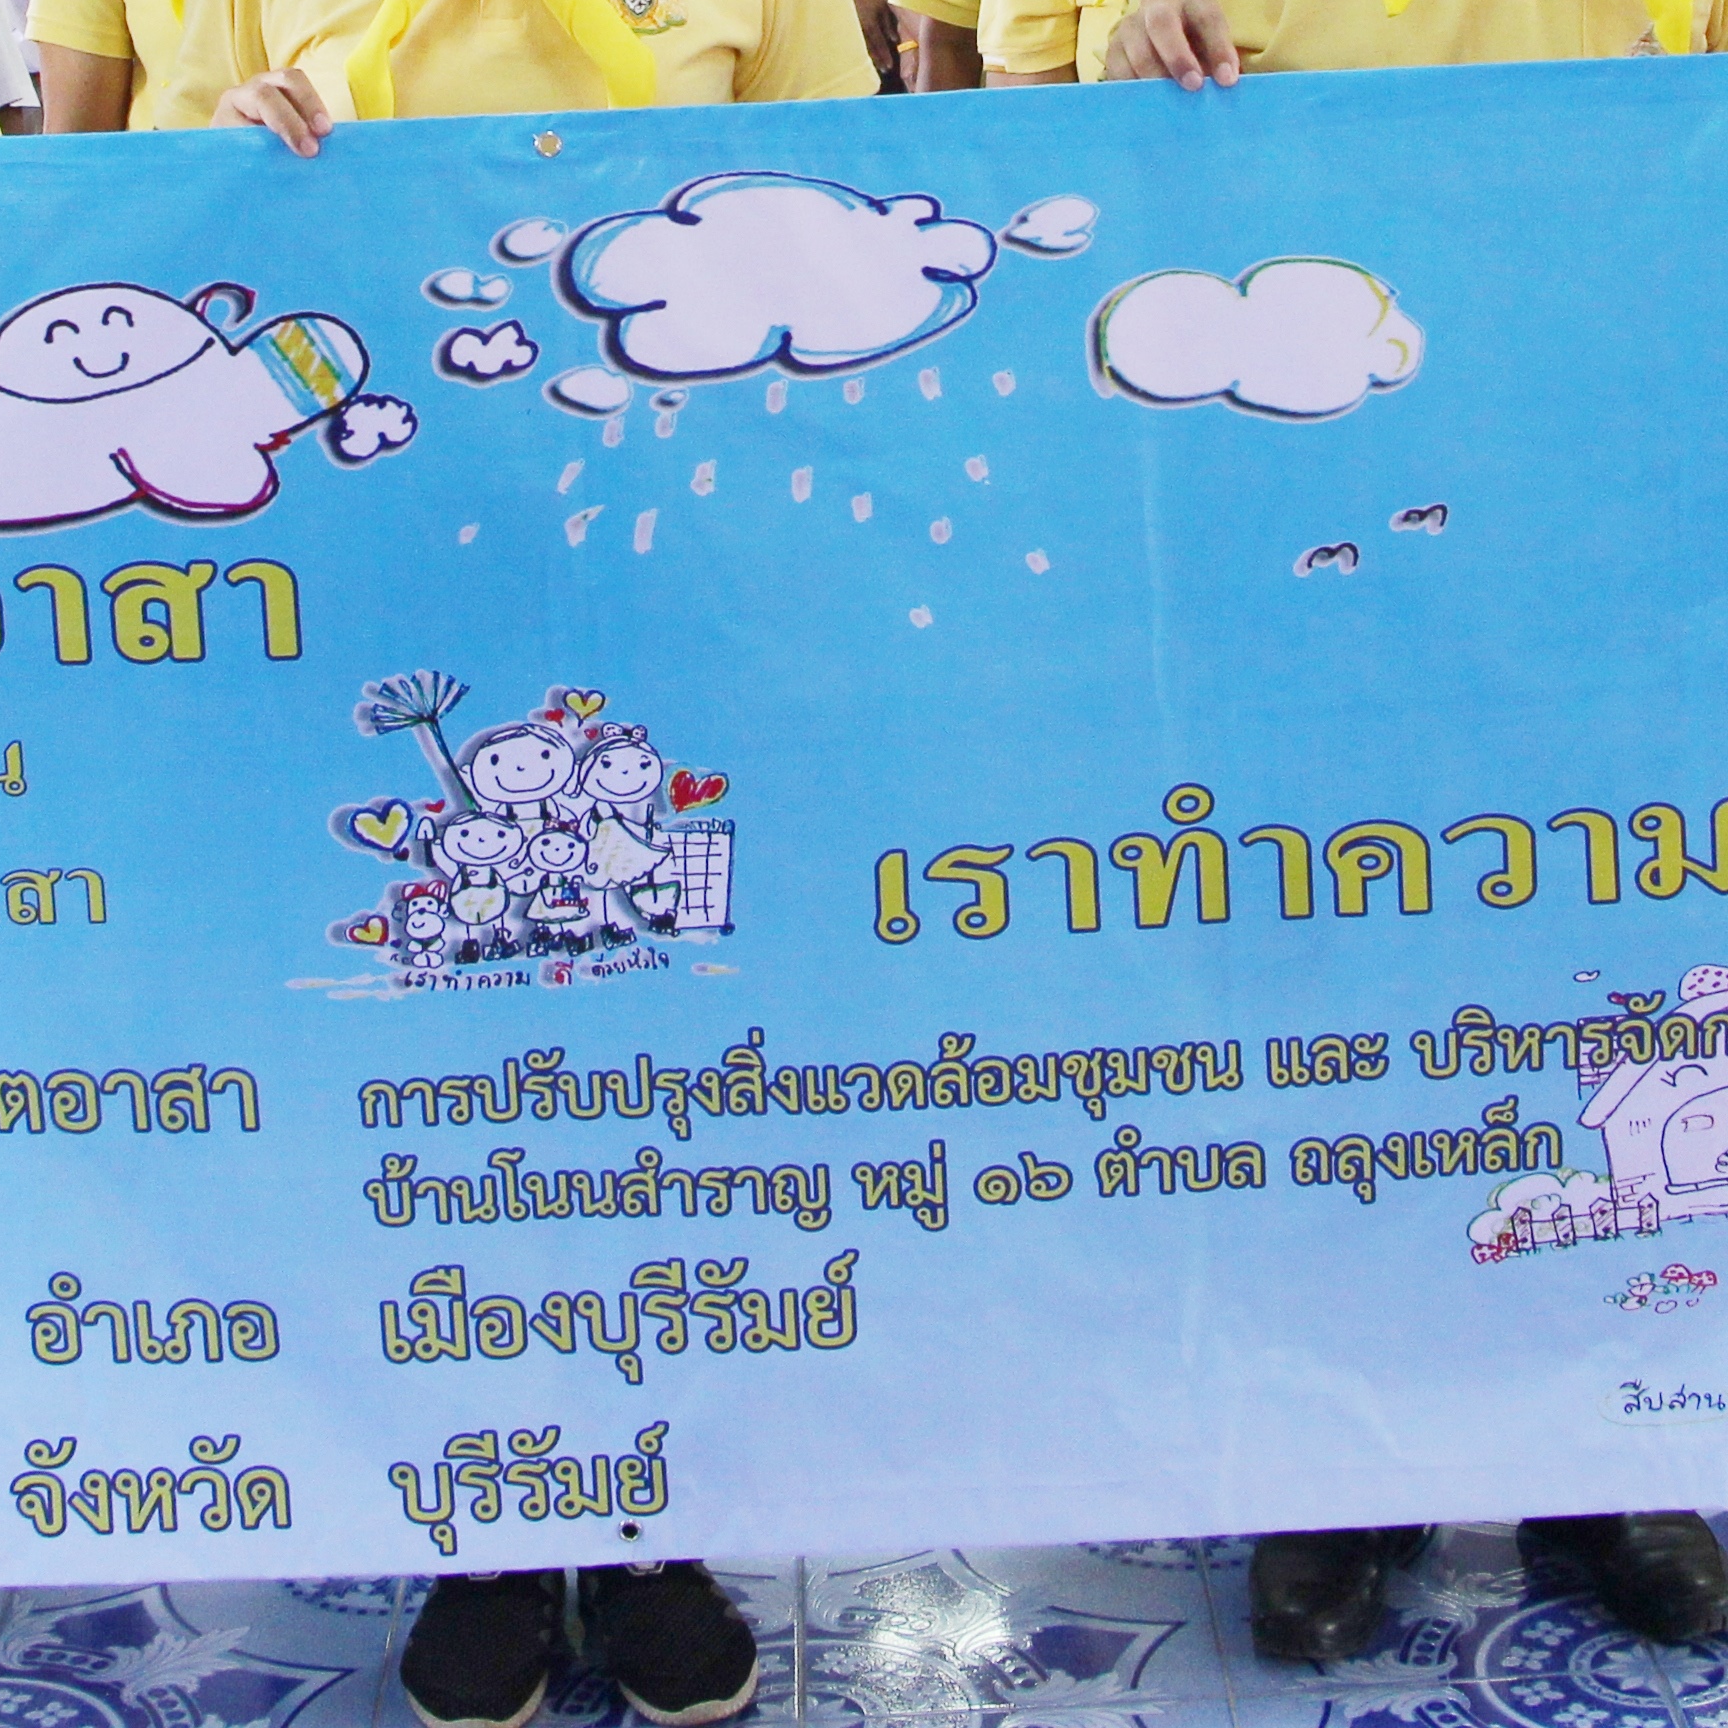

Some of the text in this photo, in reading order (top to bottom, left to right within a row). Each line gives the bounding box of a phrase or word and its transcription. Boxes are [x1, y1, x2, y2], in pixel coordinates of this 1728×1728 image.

[359, 1027, 1243, 1140] การปรับปรุงสิ่งแวดล้อมชุมชน
[1267, 1034, 1390, 1089] และ
[364, 1114, 1565, 1232] บ้านโนนสำราญ หมู่ ๑๖ ตำบล ถลุงเหล็ก
[27, 1251, 860, 1386] อำเภอ เมืองบุรีรัมย์
[1620, 1377, 1728, 1414] สืบสาน
[11, 1421, 670, 1556] จังหวัด บุรีรัมย์
